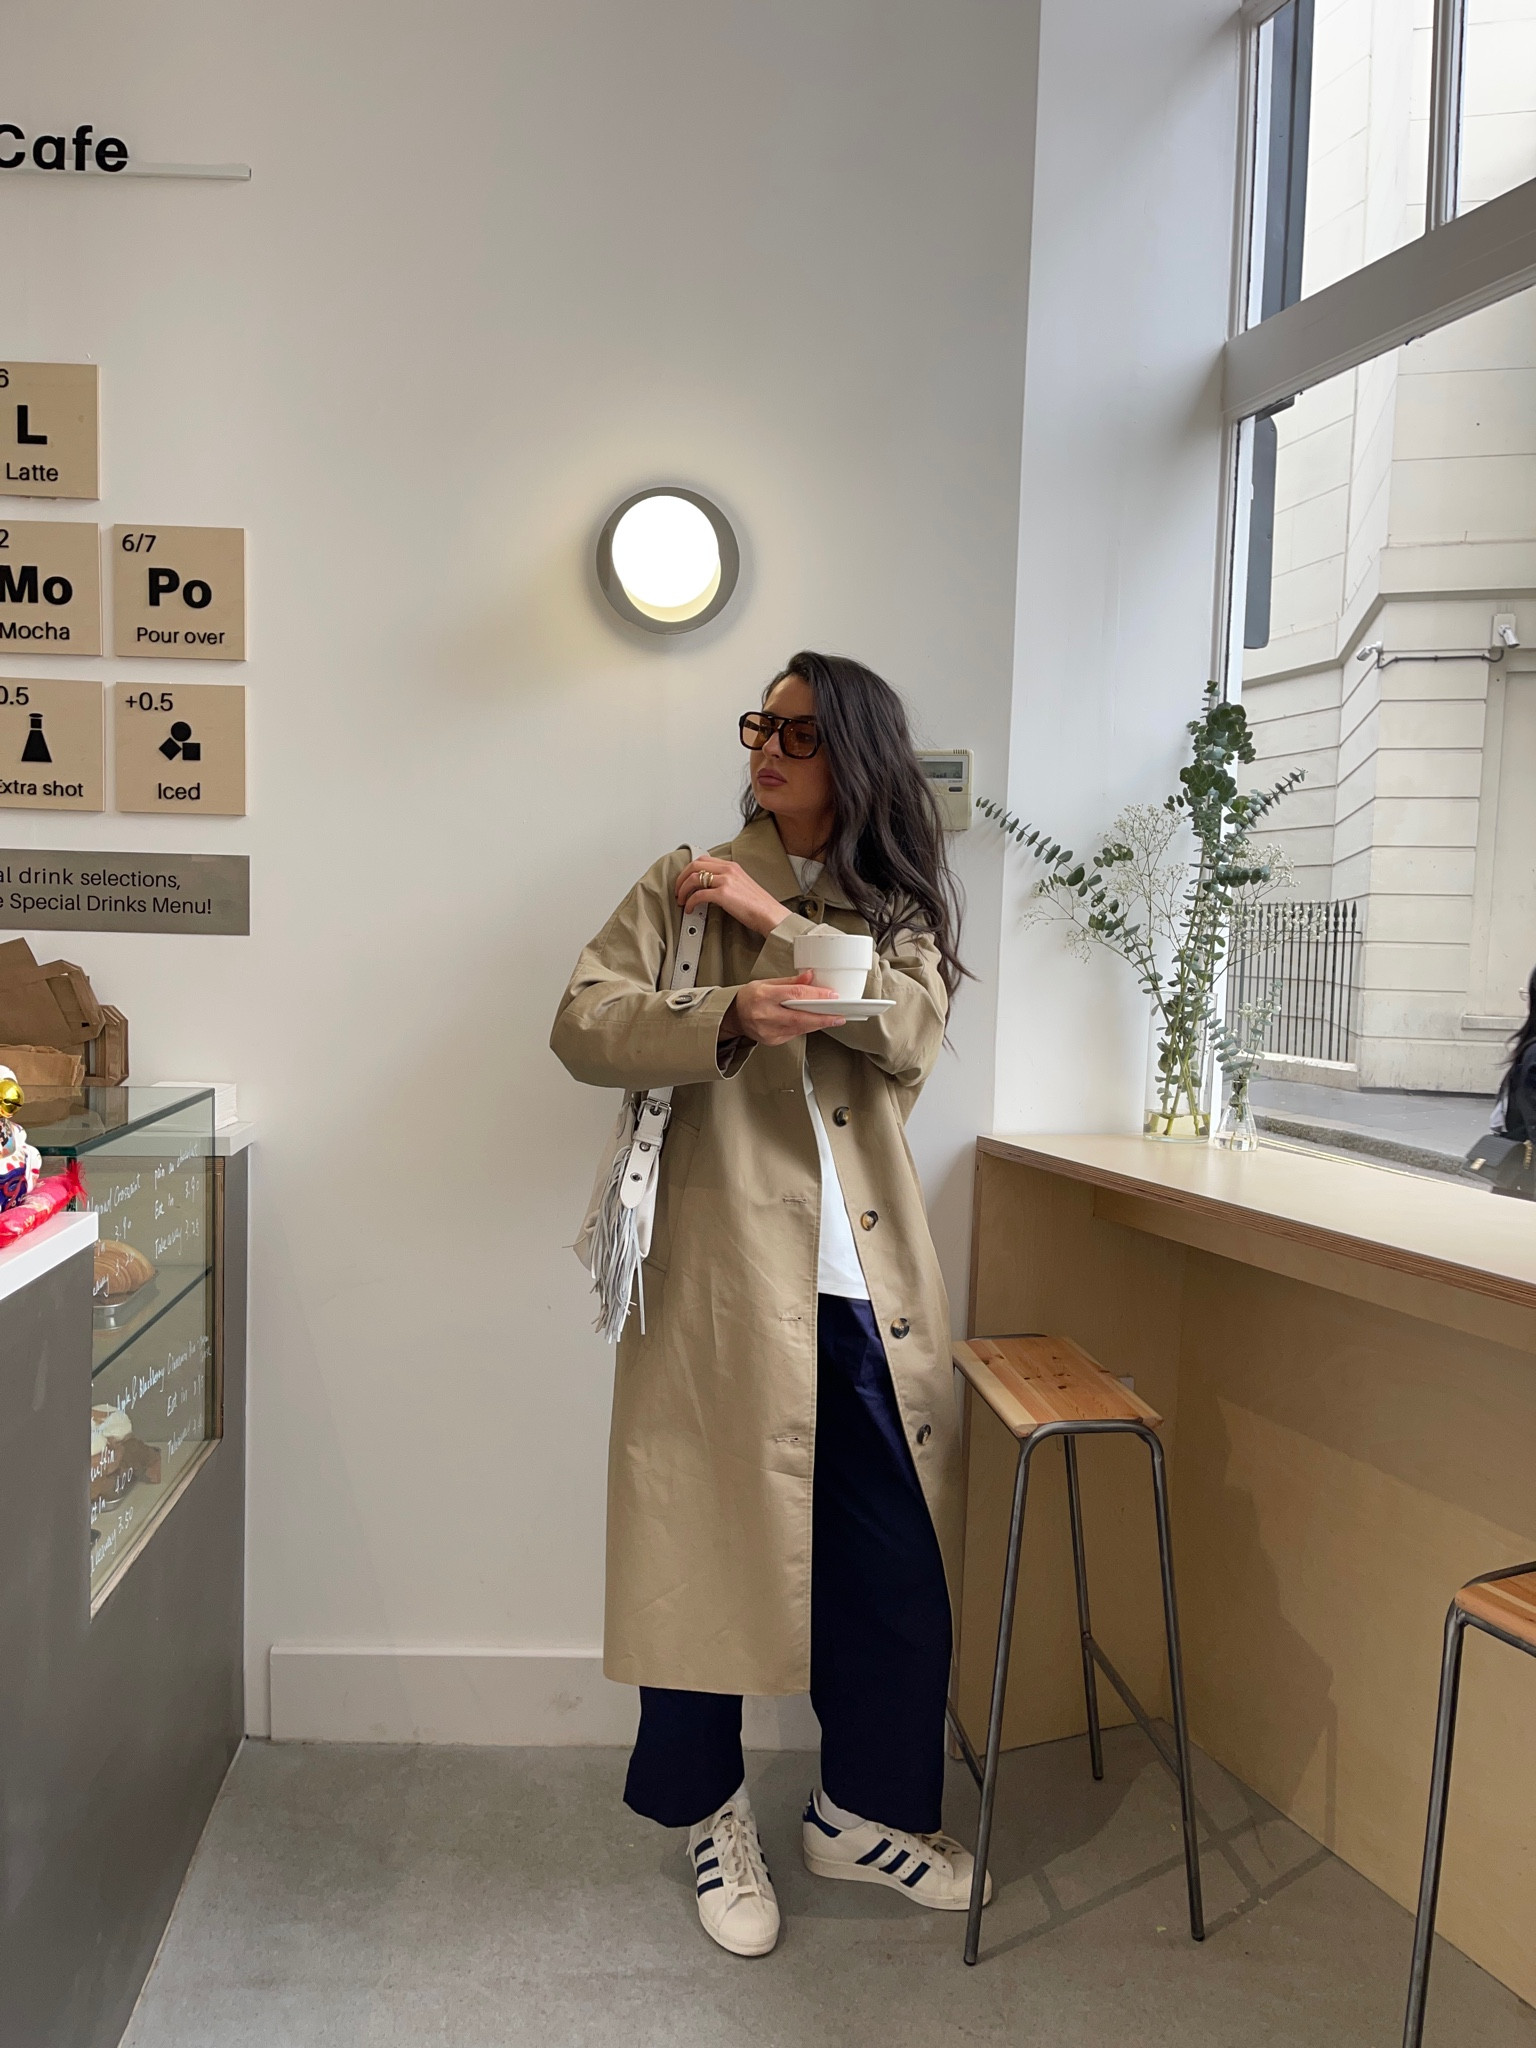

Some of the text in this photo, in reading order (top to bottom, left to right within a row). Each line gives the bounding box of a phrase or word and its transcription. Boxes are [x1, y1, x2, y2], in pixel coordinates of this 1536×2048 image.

[0, 124, 129, 172] Cafe
[17, 404, 48, 445] L
[6, 462, 59, 482] Latte
[122, 533, 157, 553] 6/7
[0, 564, 73, 606] Mo
[148, 567, 213, 609] Po
[0, 621, 70, 640] Mocha
[136, 627, 225, 645] Pour over
[125, 692, 174, 711] +0.5
[43, 780, 84, 797] shot
[158, 782, 201, 800] Iced
[19, 867, 74, 885] drink
[80, 869, 181, 891] selections,
[10, 892, 81, 914] Special
[87, 895, 147, 913] Drinks
[152, 897, 212, 915] Menu!
